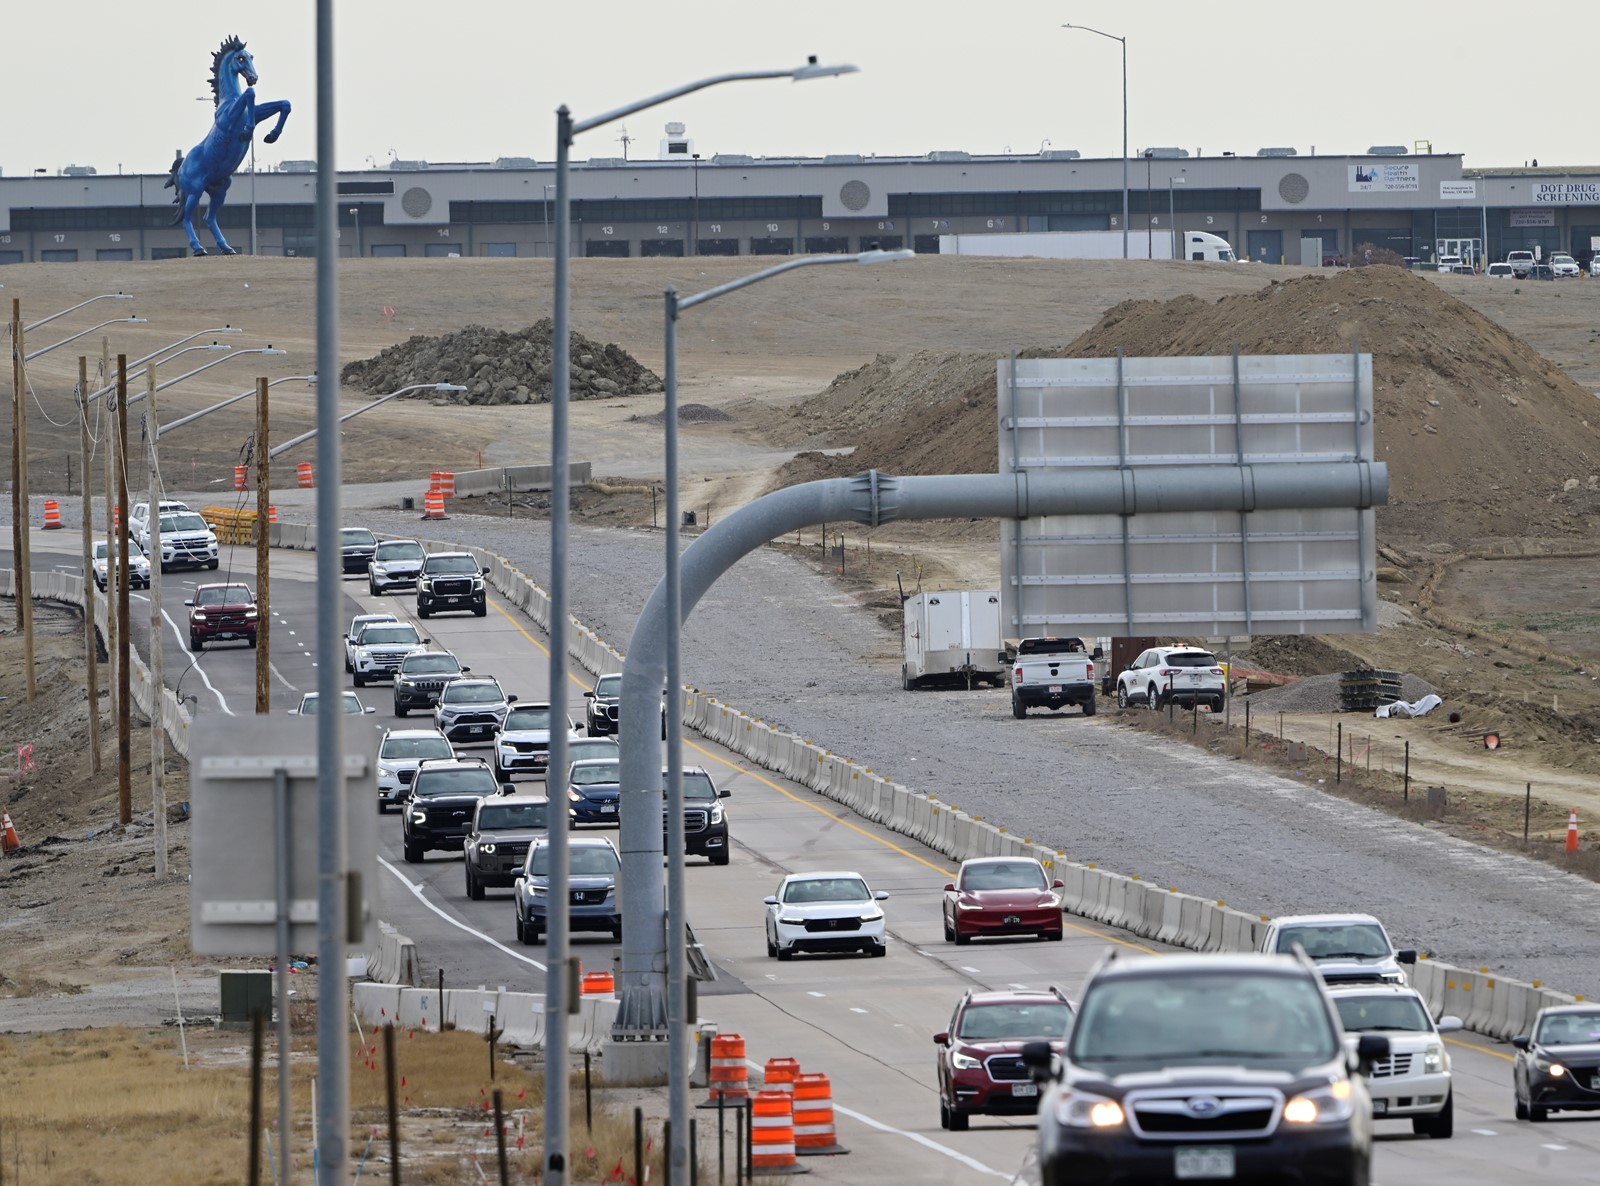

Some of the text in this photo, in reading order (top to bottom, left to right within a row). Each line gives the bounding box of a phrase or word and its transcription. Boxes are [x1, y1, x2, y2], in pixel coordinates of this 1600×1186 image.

[1541, 184, 1596, 193] DOT DRUG
[1536, 192, 1600, 201] SCREENING
[987, 220, 993, 228] 6
[1111, 217, 1117, 225] 5
[1151, 217, 1158, 225] 4
[1207, 216, 1213, 224] 3
[711, 224, 721, 233] 11
[766, 224, 778, 232] 10
[823, 223, 830, 231] 9
[878, 222, 884, 230] 8
[933, 221, 939, 229] 7
[437, 229, 449, 237] 14
[602, 226, 613, 235] 13
[656, 226, 668, 234] 12
[54, 234, 65, 243] 17
[109, 234, 120, 242] 16
